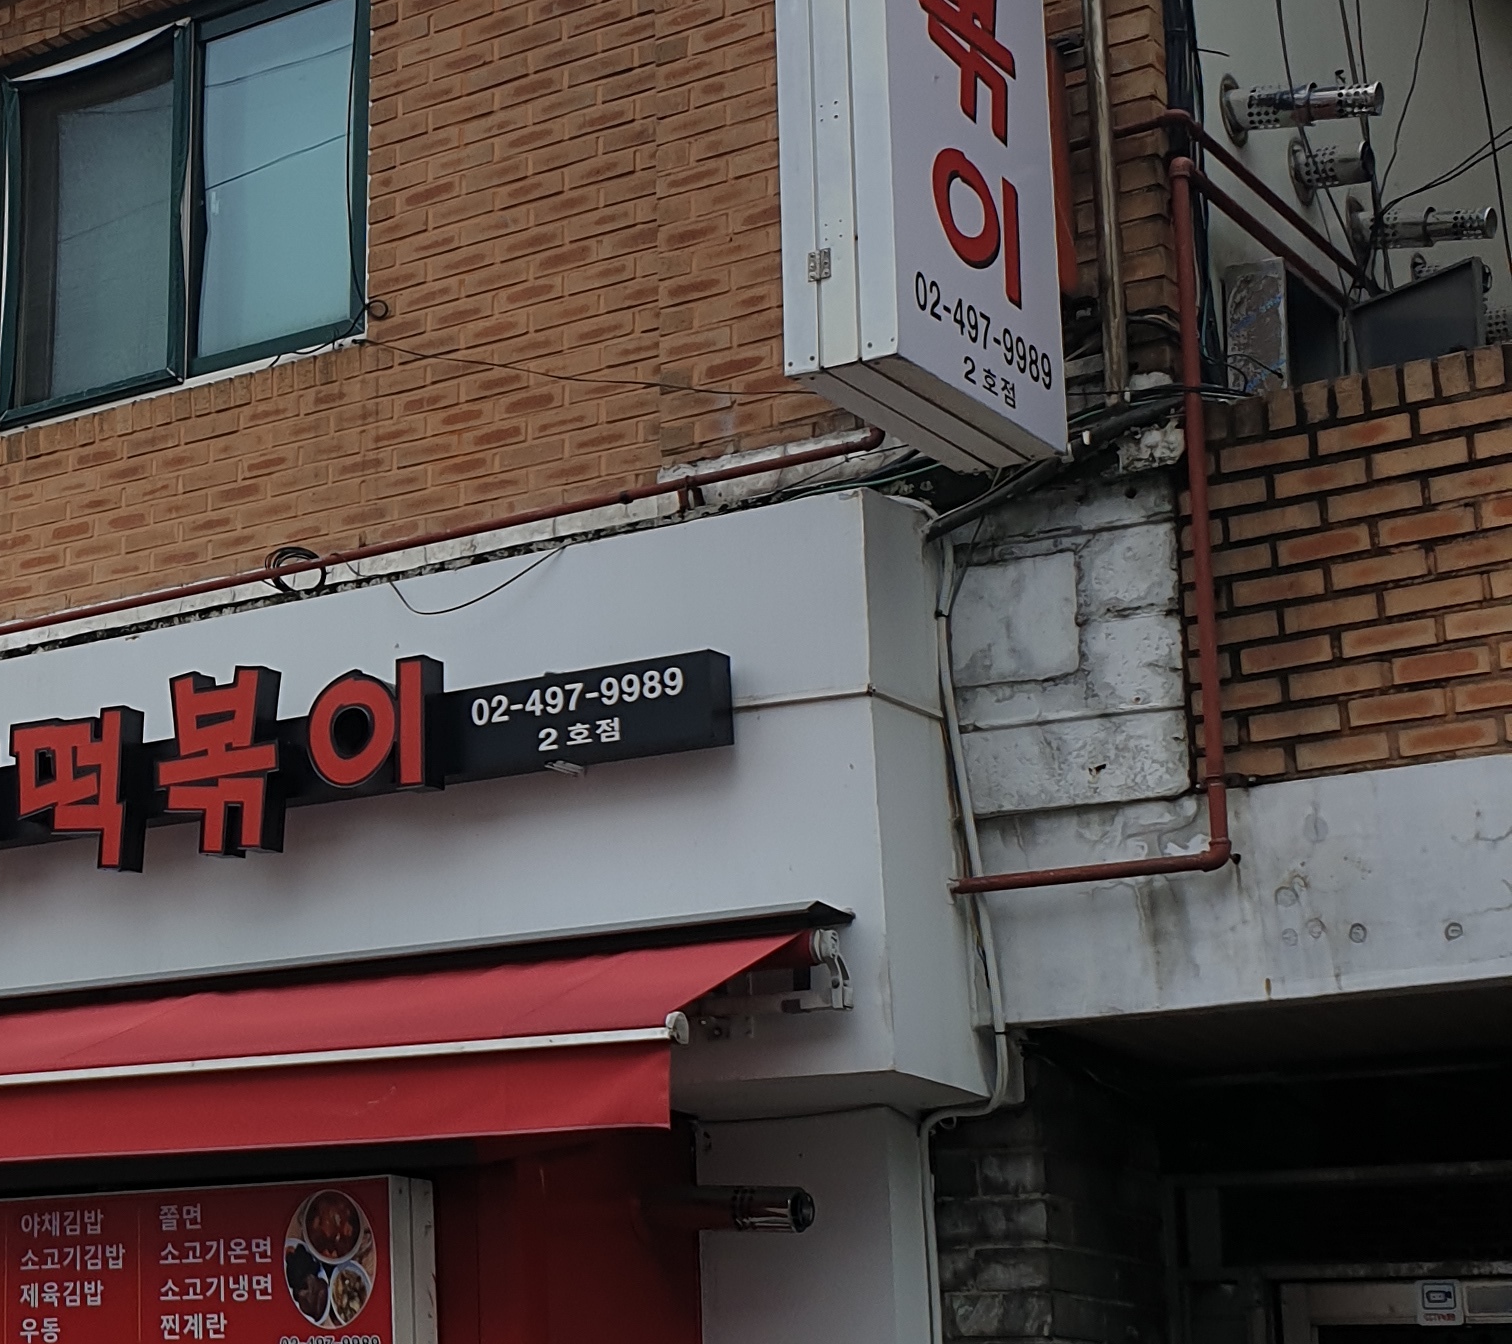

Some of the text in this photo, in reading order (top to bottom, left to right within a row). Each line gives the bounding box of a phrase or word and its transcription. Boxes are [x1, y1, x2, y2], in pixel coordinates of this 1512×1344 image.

[914, 270, 1053, 391] 02-497-9989
[471, 666, 684, 727] 02-497-9989
[10, 657, 431, 870] 떡볶이
[20, 1209, 105, 1238] 야채김밥
[159, 1203, 202, 1231] 쫄면
[20, 1243, 126, 1271] 소고기김밥
[159, 1236, 273, 1266] 소고기온면
[19, 1279, 105, 1308] 제육김밥
[159, 1273, 274, 1303] 소고기냉면
[19, 1317, 61, 1344] 우동
[160, 1312, 228, 1341] 찐계란
